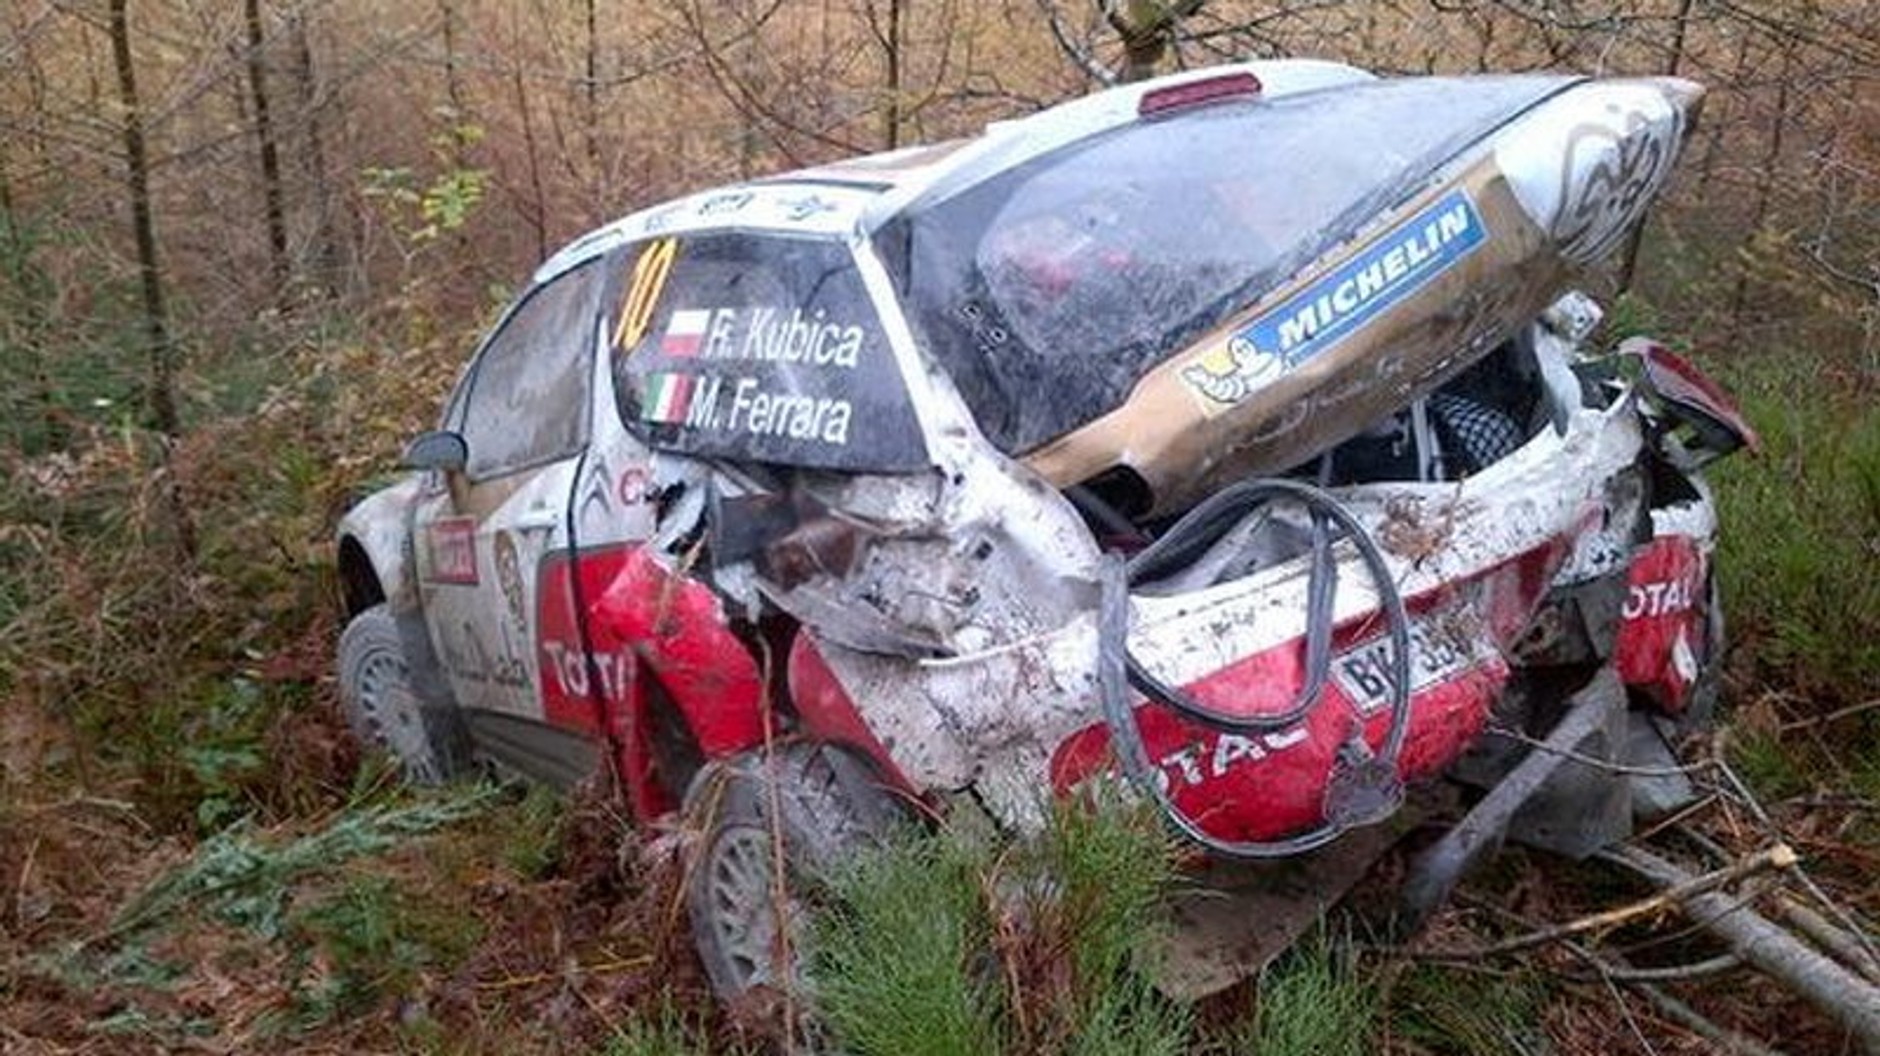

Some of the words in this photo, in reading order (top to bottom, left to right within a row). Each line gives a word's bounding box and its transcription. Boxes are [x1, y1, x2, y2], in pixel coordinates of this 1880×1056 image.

[611, 237, 678, 349] 10
[1278, 203, 1469, 351] MICHELIN
[742, 305, 865, 367] Kubica
[686, 376, 721, 433] M.
[729, 376, 853, 443] Ferrara
